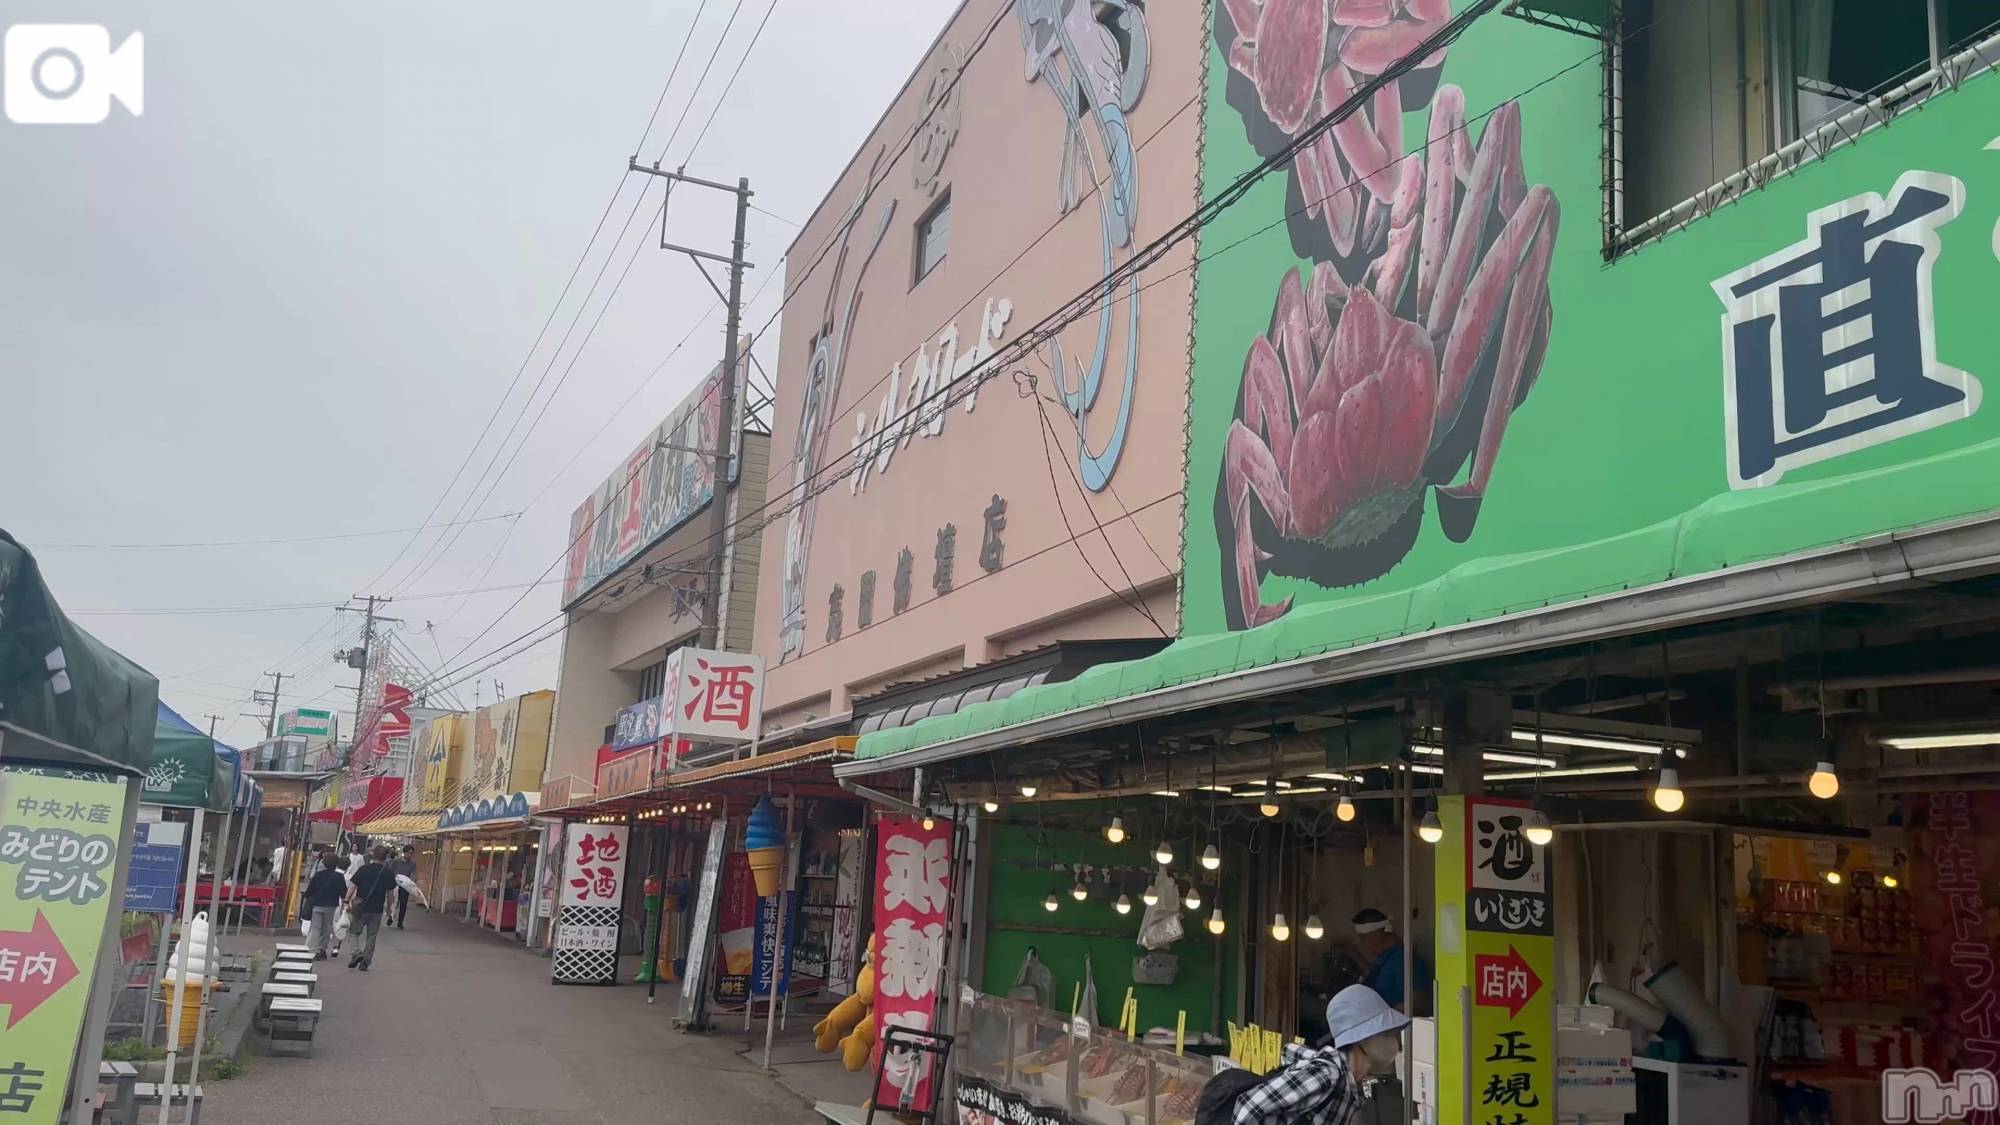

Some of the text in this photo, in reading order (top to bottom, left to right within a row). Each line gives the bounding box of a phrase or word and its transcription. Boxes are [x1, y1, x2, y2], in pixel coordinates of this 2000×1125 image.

[1726, 137, 2000, 483] 直
[684, 657, 755, 732] 酒
[16, 796, 112, 824] 中央水産
[1, 830, 109, 865] みどりの
[1478, 815, 1535, 881] 酒
[23, 867, 101, 899] テント
[570, 832, 621, 901] 地酒
[1474, 893, 1546, 930] いしざき
[560, 938, 615, 948] 日本酒・ワイン
[0, 948, 58, 985] 店内
[1482, 963, 1528, 999] 店内
